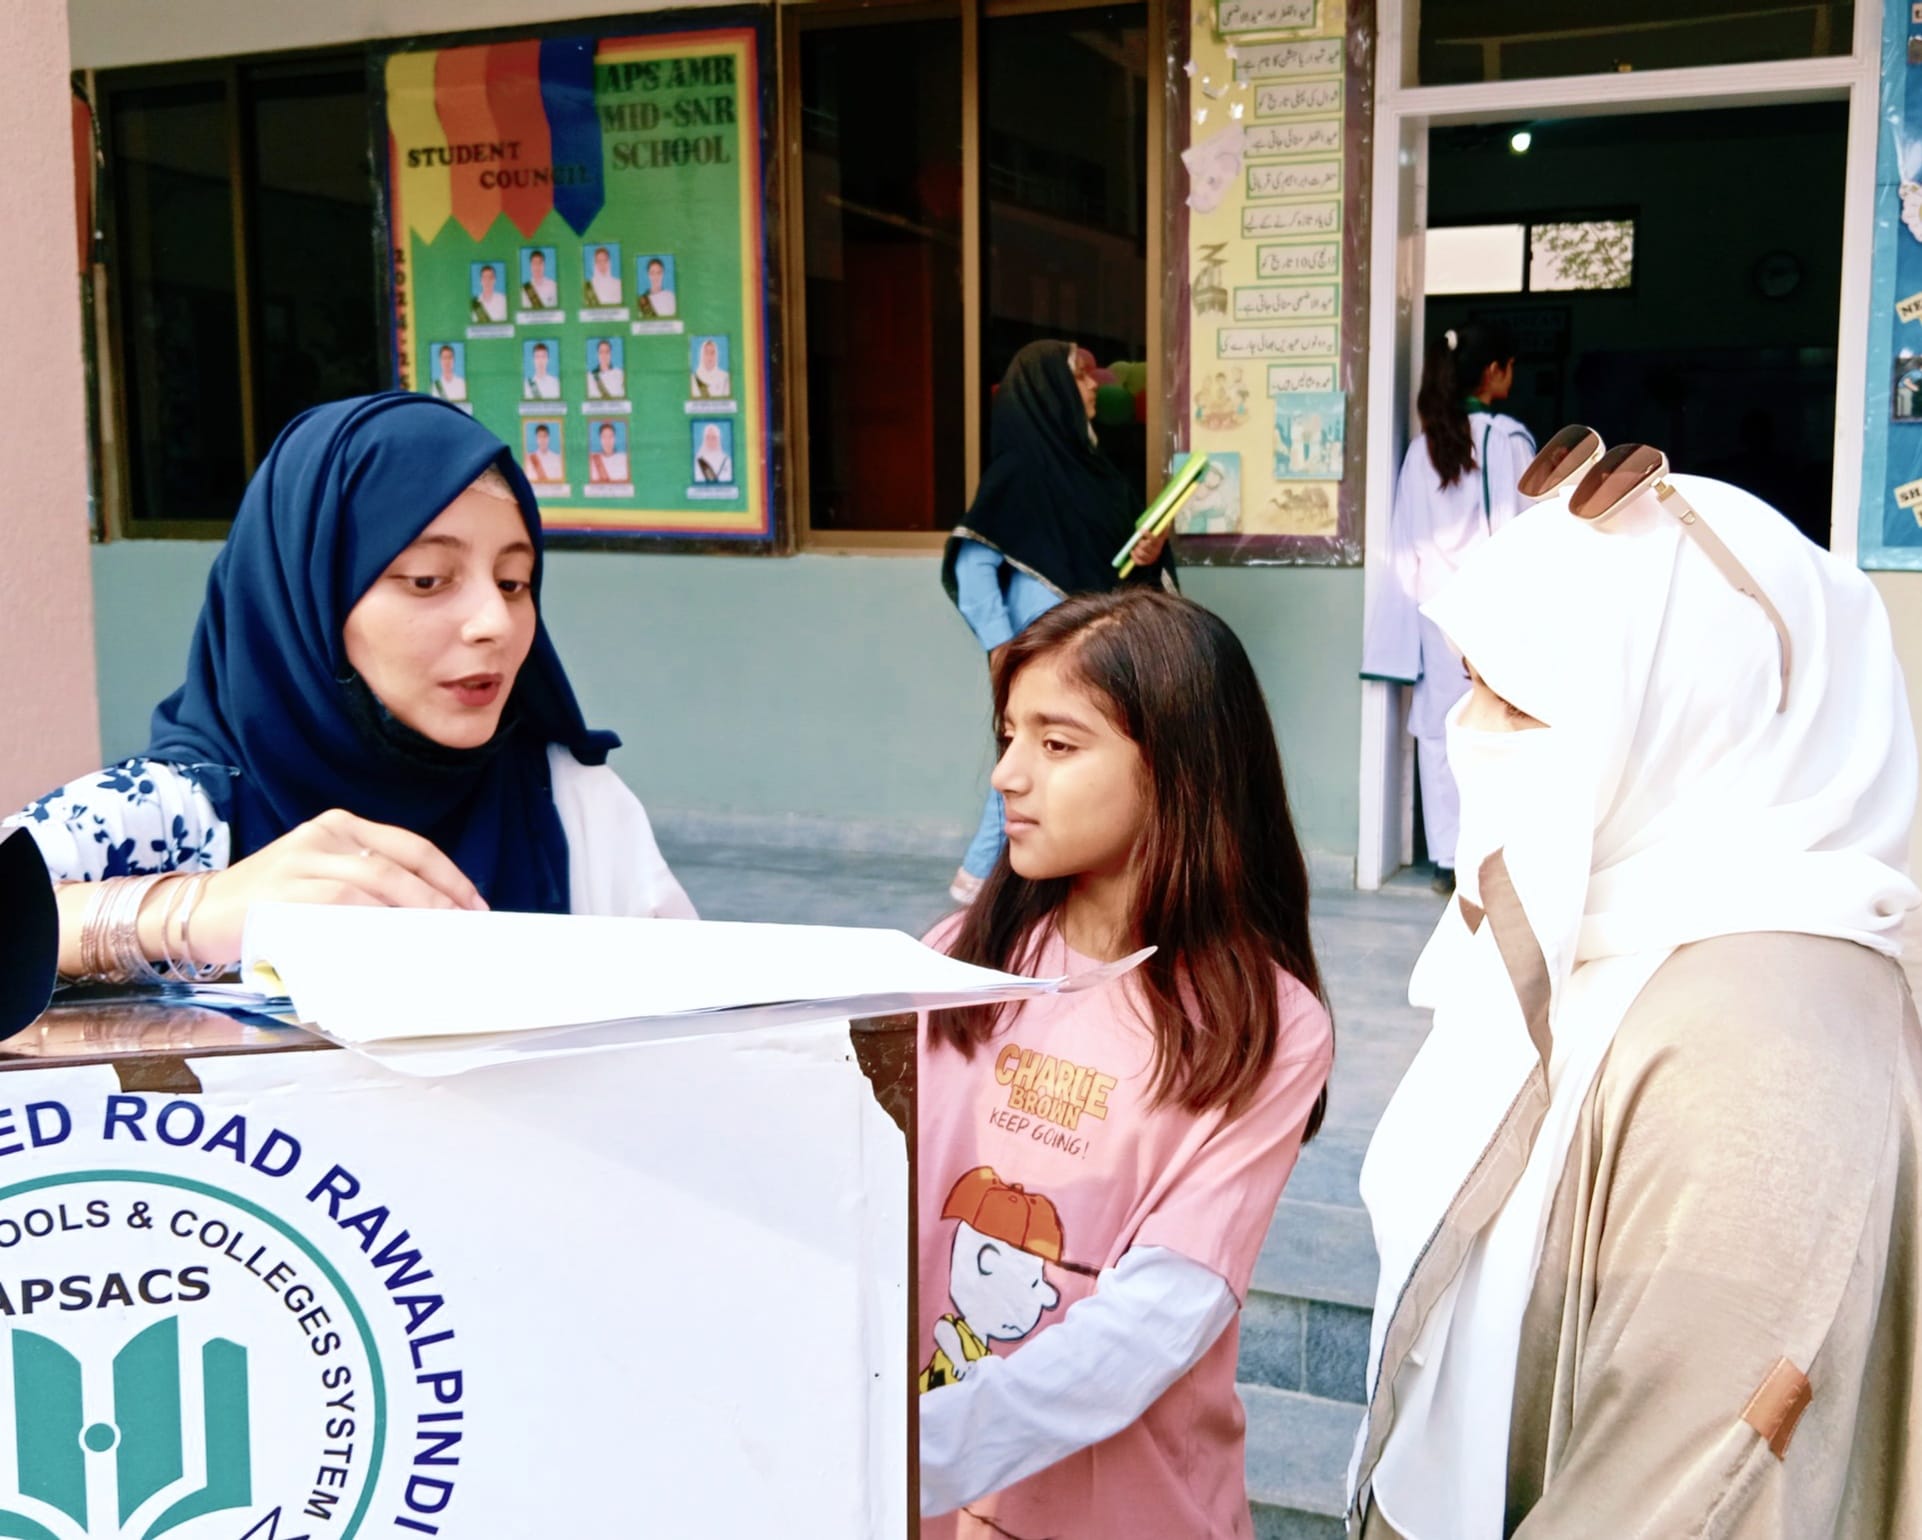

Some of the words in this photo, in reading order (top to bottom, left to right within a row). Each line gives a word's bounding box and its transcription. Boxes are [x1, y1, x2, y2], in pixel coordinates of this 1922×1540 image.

[605, 61, 660, 93] APS
[666, 56, 736, 90] AMR
[406, 141, 521, 169] STUDENT
[611, 135, 731, 171] SCHOOL
[479, 165, 591, 190] COUNCIL
[989, 1106, 1031, 1134] KEEP
[1008, 1084, 1081, 1131] BROWN
[103, 1095, 302, 1177] ROAD
[306, 1164, 464, 1535] RAWALPINDI
[0, 1200, 110, 1248] OOLS
[127, 1201, 153, 1229] &
[170, 1210, 341, 1356] COLLEGES
[303, 1366, 355, 1520] SYSTEM
